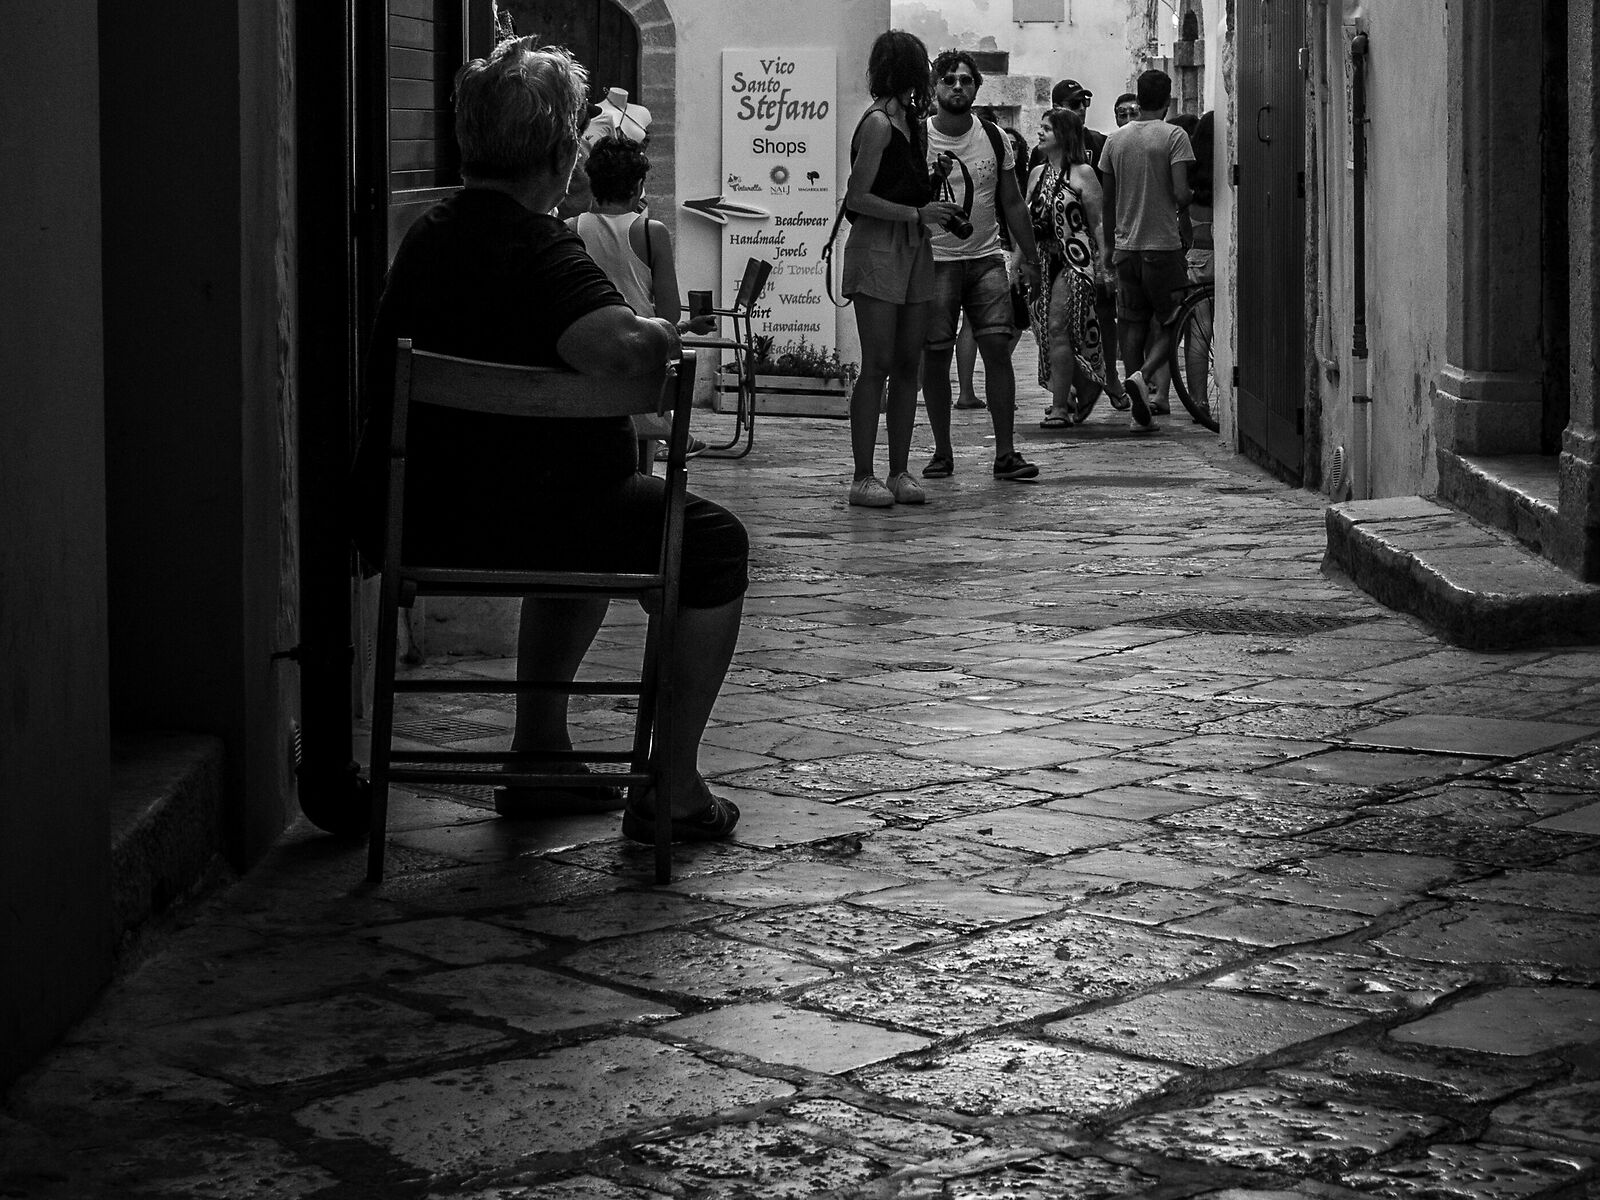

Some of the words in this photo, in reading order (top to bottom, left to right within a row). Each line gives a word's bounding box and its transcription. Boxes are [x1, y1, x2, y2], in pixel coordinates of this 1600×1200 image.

[759, 56, 796, 74] Vico
[731, 71, 781, 93] Santo
[736, 88, 830, 131] Stefano
[752, 138, 807, 157] Shops
[774, 211, 829, 227] Beachwear
[729, 230, 786, 245] Handmade
[772, 242, 808, 260] Jewels
[787, 261, 824, 275] Towels
[778, 289, 821, 305] Watches
[762, 320, 821, 332] Hawaianas
